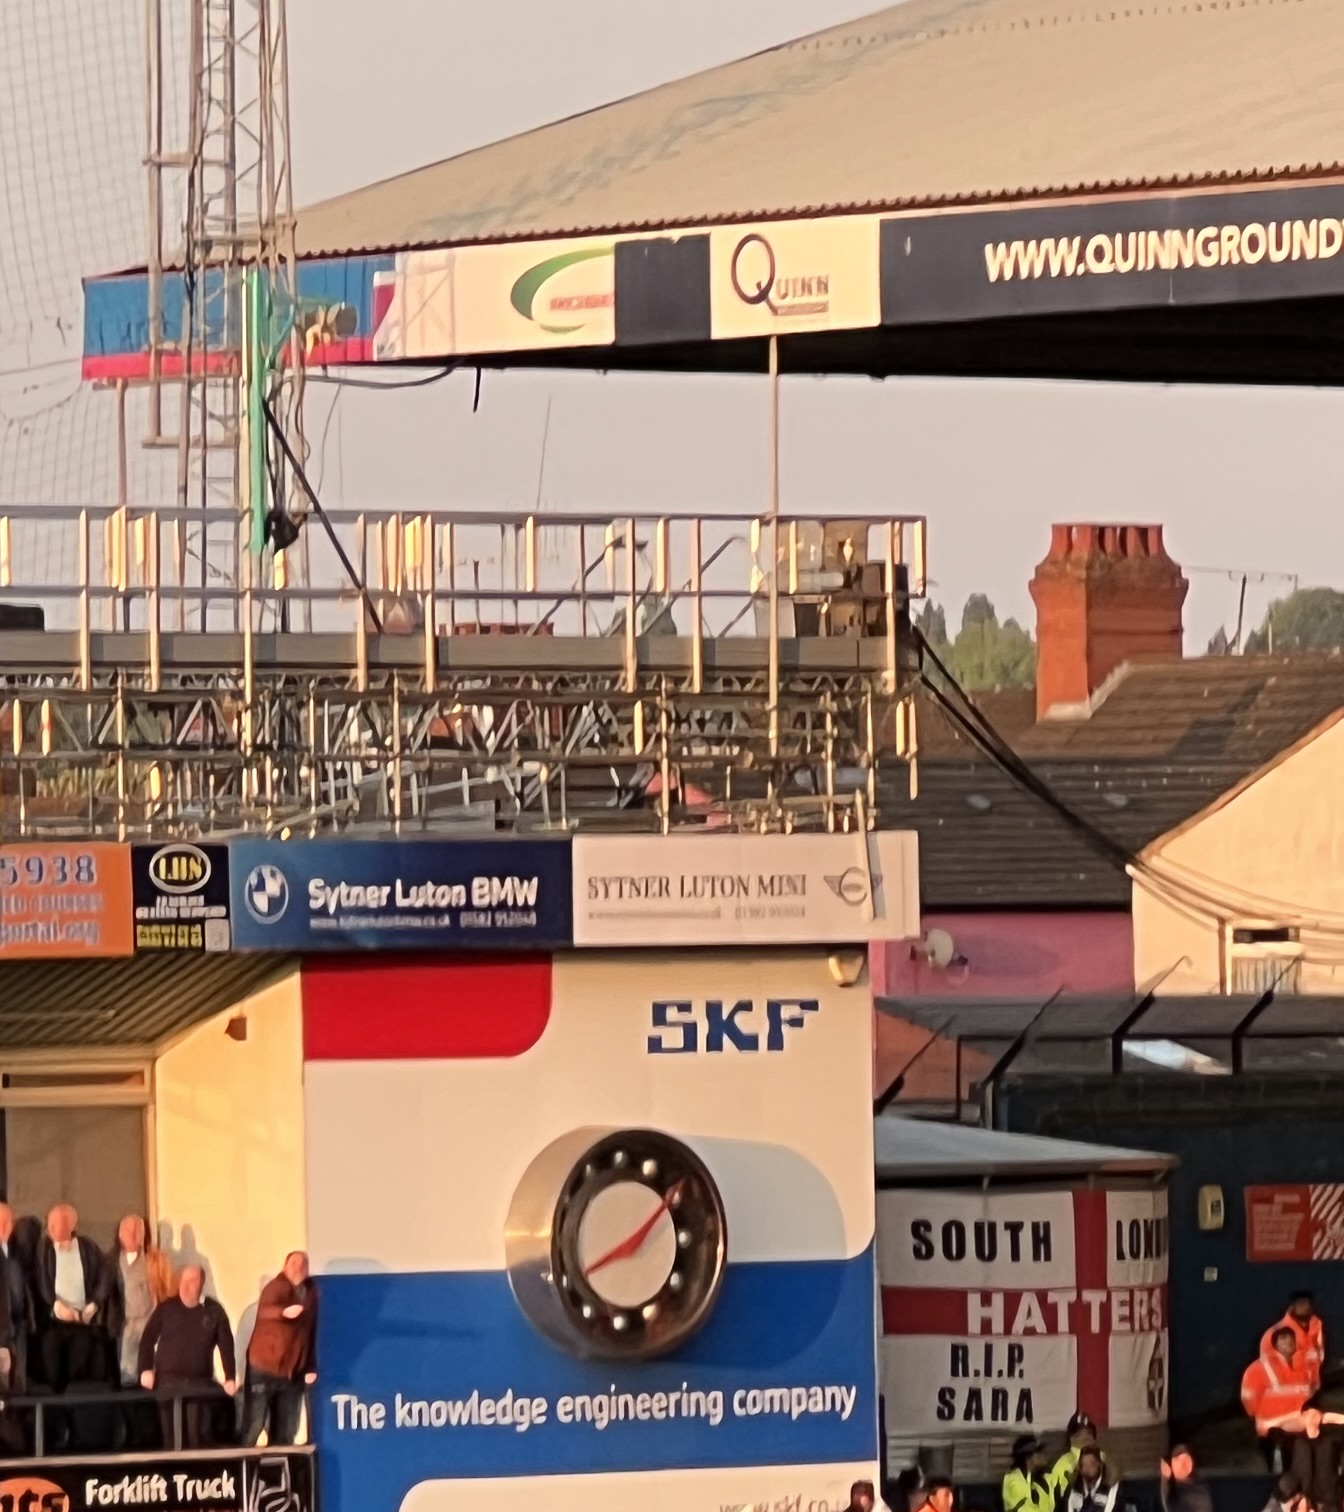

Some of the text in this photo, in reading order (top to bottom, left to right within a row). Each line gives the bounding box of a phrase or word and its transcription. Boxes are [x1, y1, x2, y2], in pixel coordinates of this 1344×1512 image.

[308, 876, 539, 916] Sytner Luton BMW
[588, 873, 807, 899] SYTNER LUTON MINI
[647, 999, 819, 1054] SKF
[911, 1218, 1051, 1262] SOUTH
[967, 1286, 1162, 1335] HATTERS
[331, 1379, 856, 1430] The knowledge engineering company
[936, 1386, 1033, 1423] SARA
[85, 1469, 235, 1505] Forklift Truck
